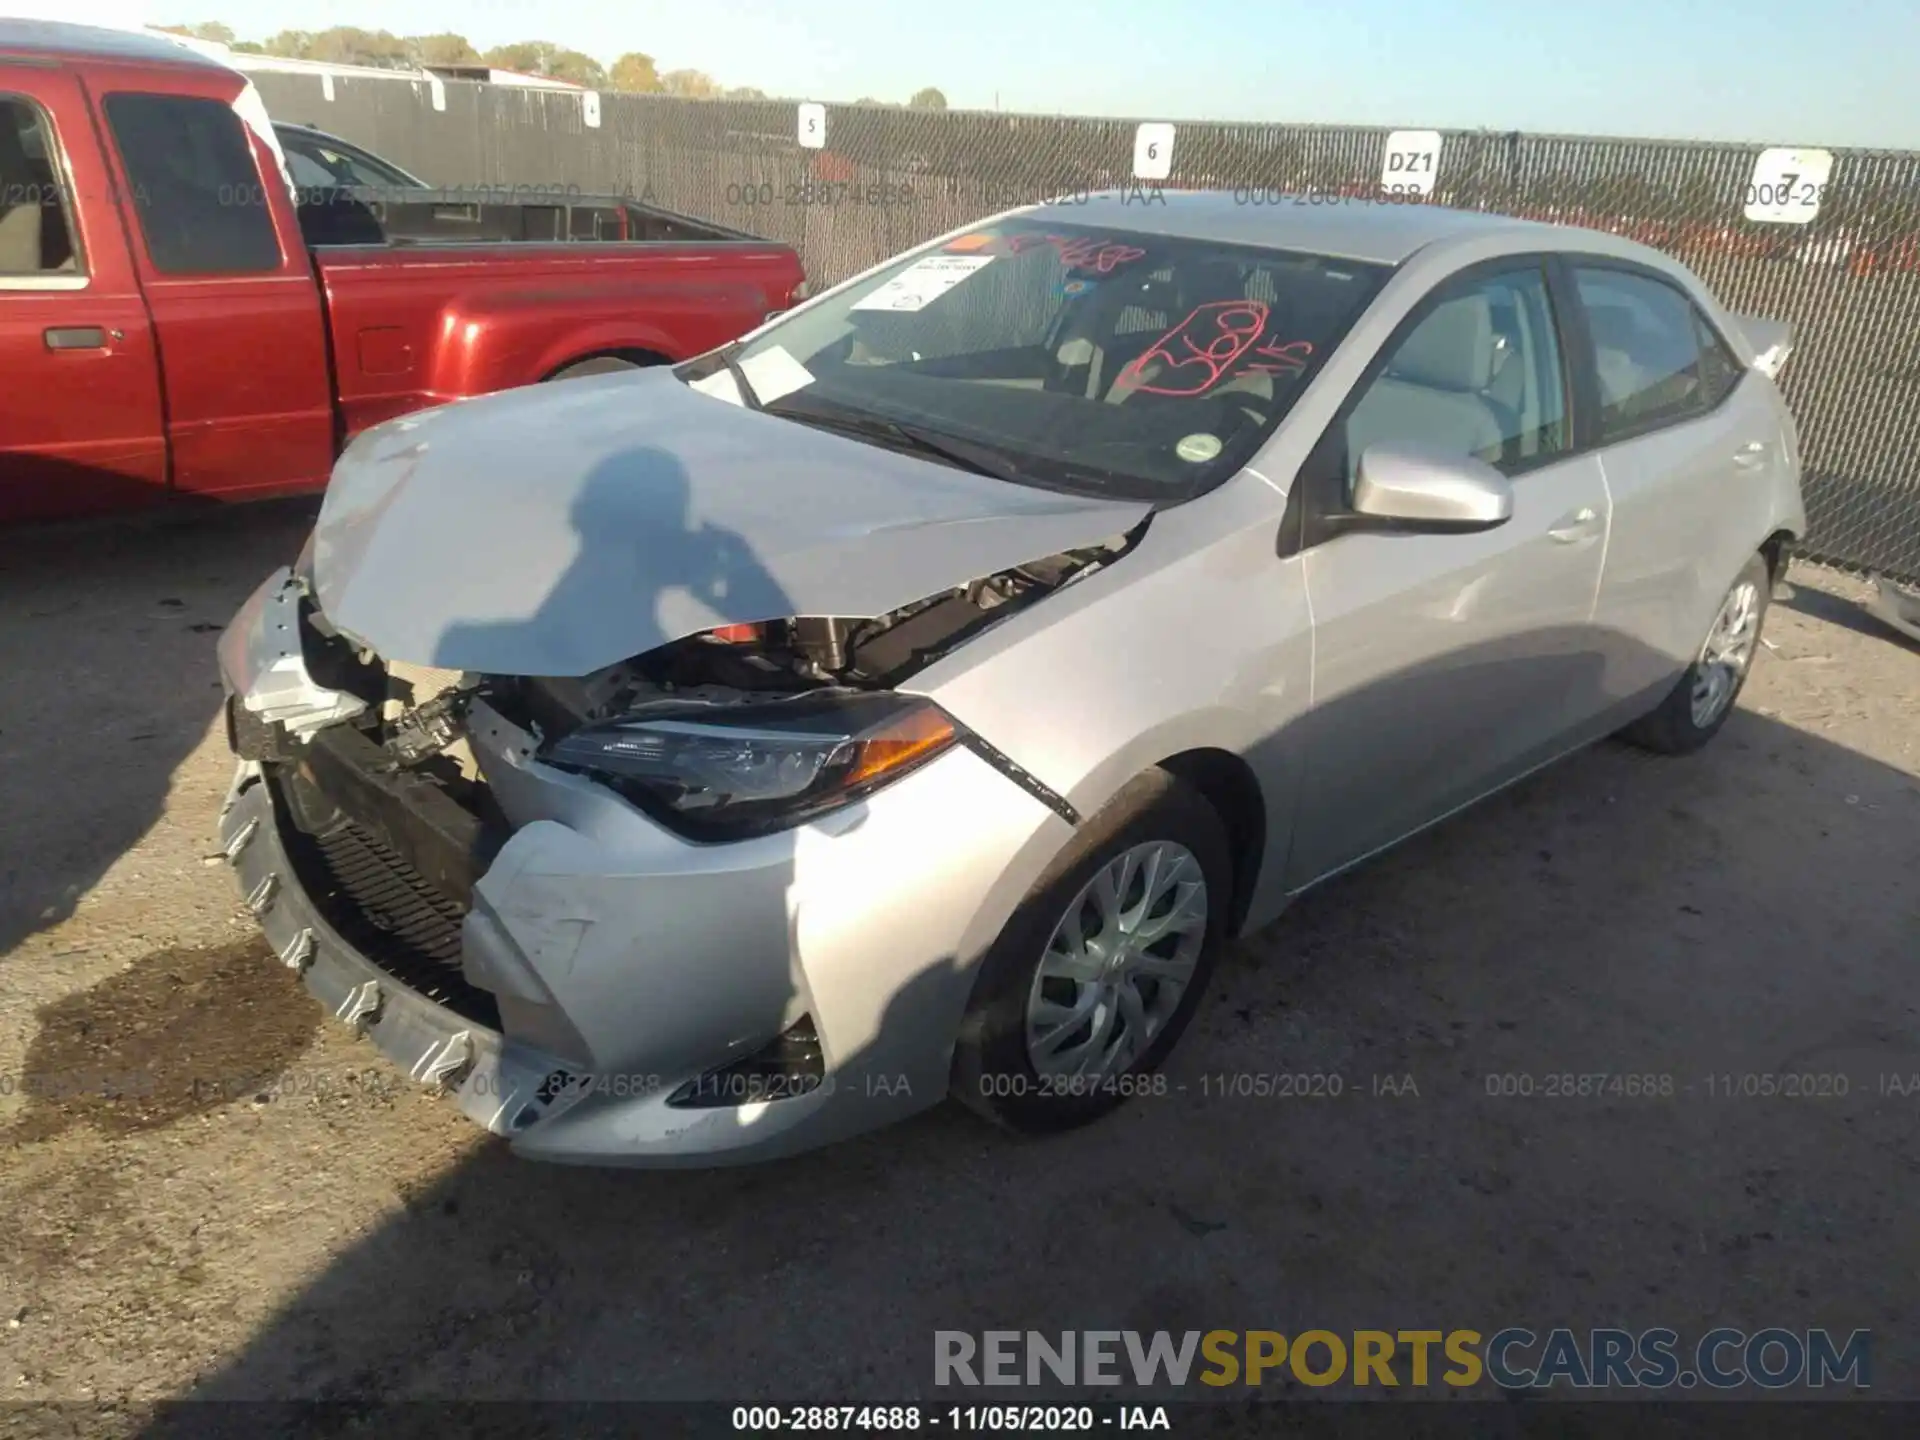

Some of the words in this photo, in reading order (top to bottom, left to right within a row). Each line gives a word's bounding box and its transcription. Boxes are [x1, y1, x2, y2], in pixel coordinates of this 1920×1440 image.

[808, 118, 816, 133] 5
[1148, 142, 1158, 160] 6
[1388, 151, 1433, 173] DZ1
[1781, 173, 1800, 198] 7
